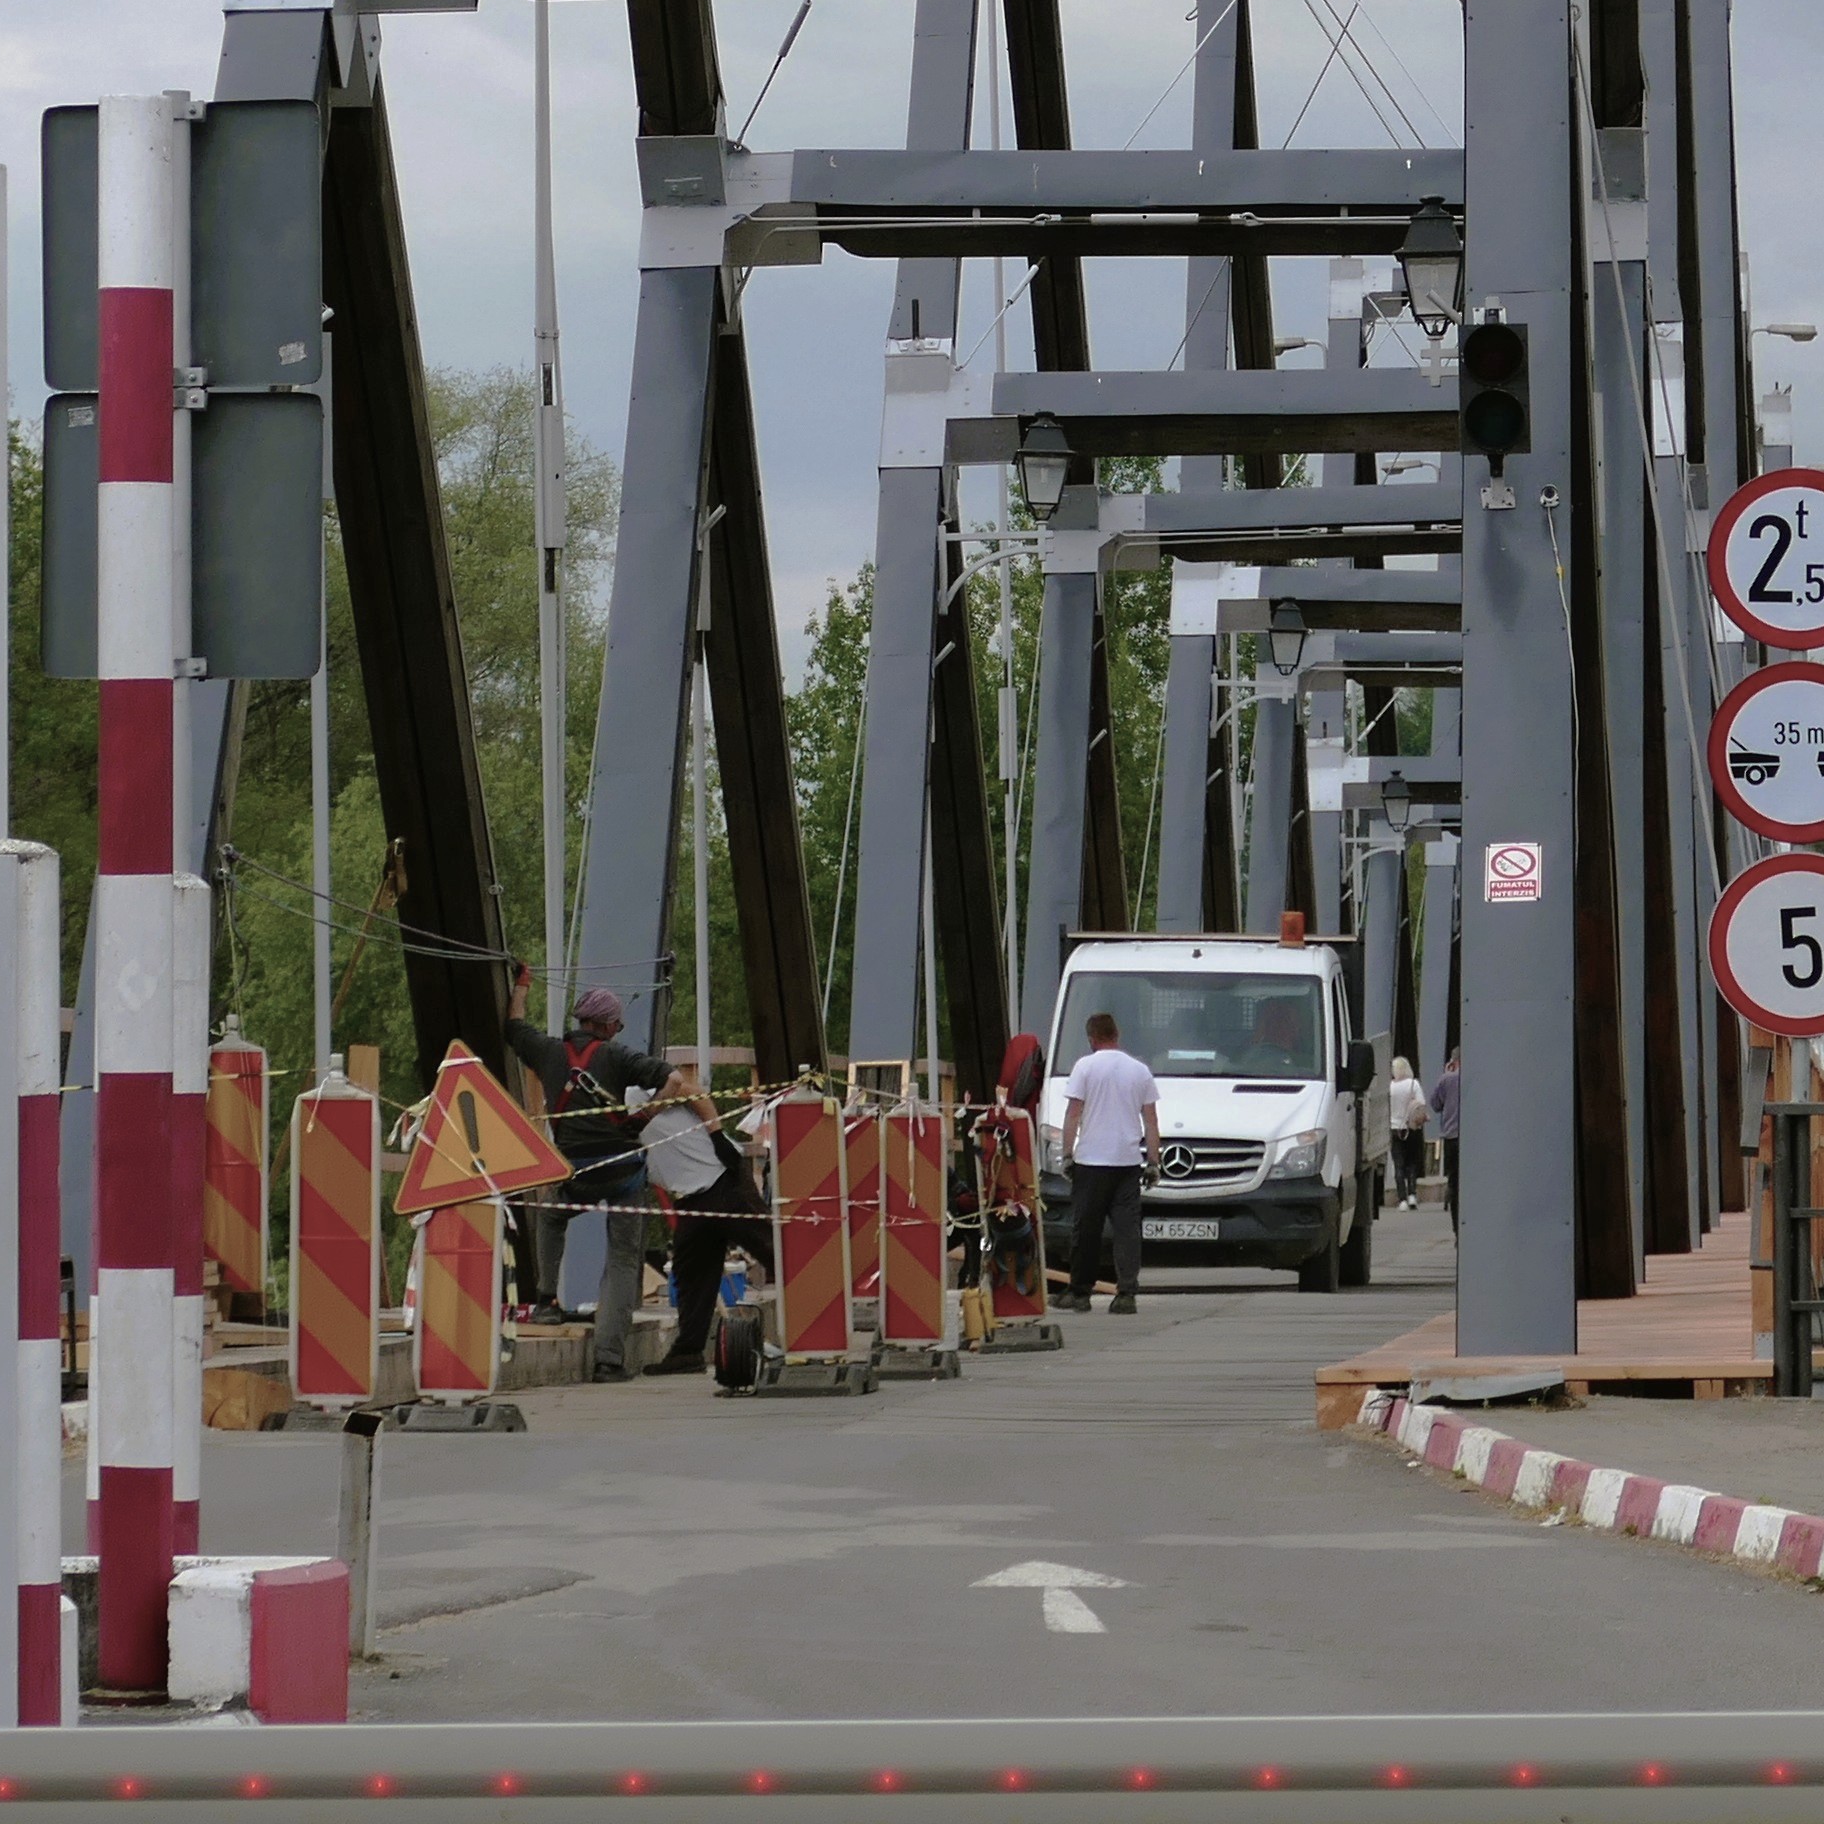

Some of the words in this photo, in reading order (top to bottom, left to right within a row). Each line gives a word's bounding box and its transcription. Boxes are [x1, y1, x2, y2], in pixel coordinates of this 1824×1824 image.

[1773, 722, 1800, 746] 35
[1807, 726, 1824, 744] m
[1779, 906, 1823, 988] 5
[1145, 1223, 1163, 1236] SM
